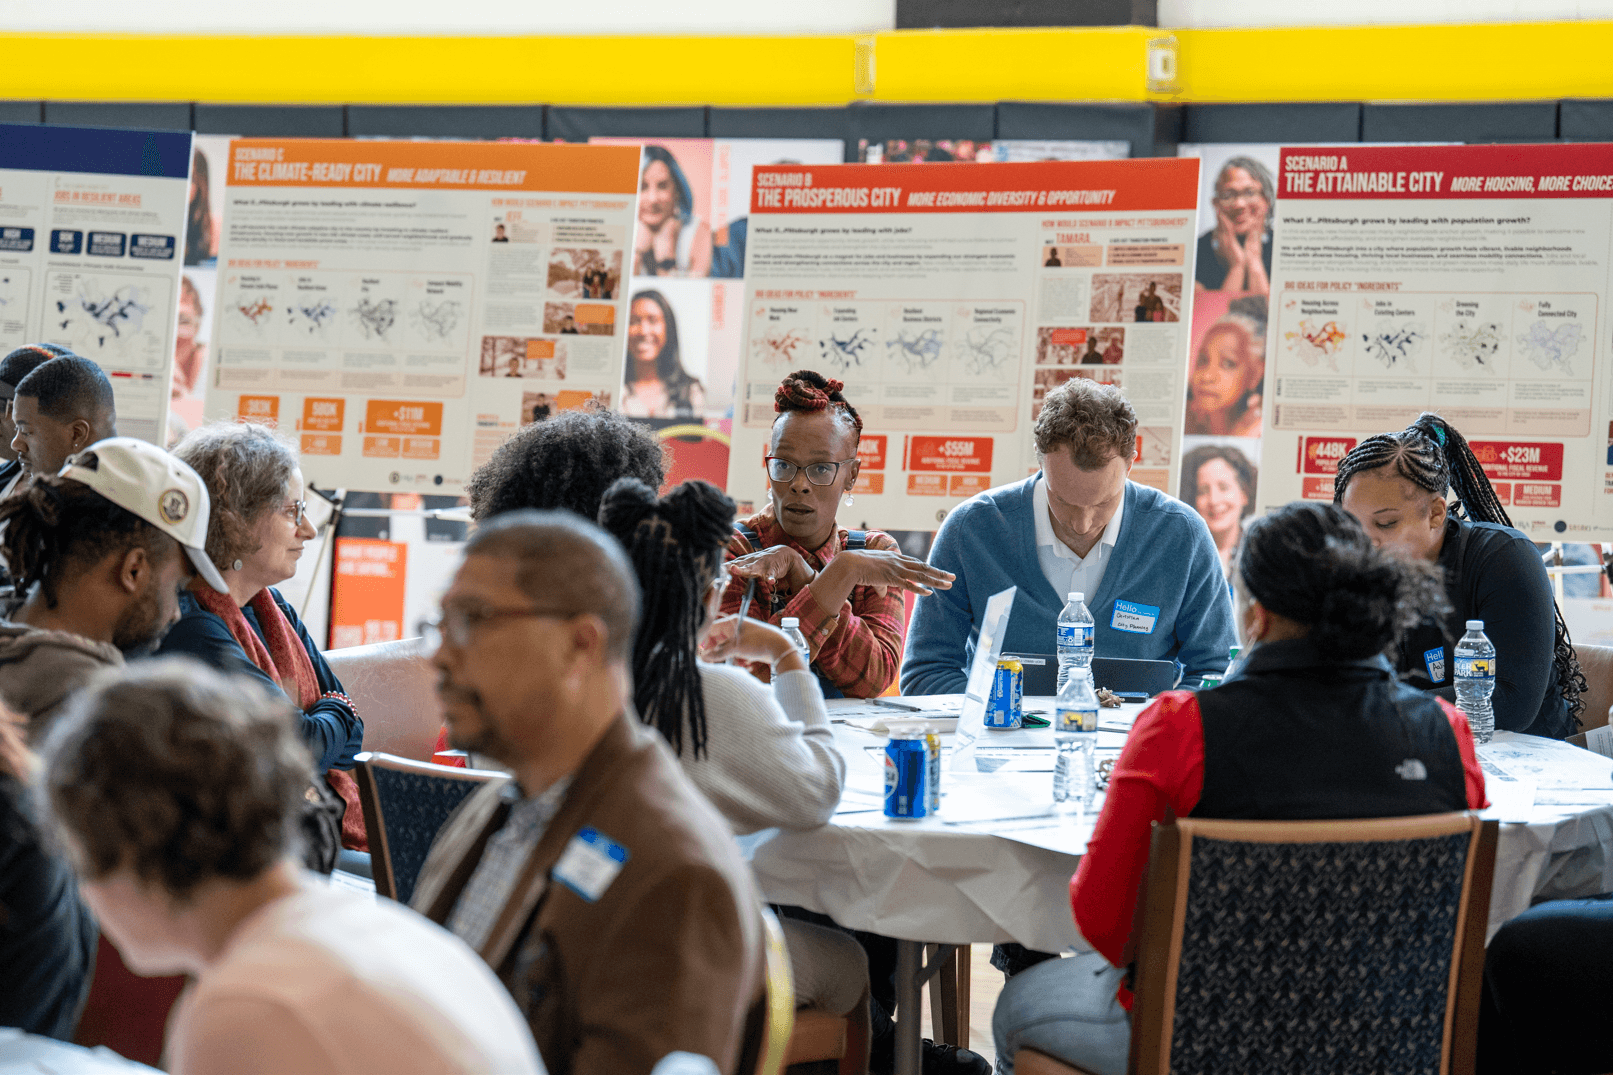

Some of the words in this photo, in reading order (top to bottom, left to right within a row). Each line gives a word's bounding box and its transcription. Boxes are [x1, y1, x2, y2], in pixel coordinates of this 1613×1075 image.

[235, 148, 275, 160] SCENARIO
[1285, 156, 1338, 171] SCENARIO
[1339, 156, 1348, 170] A
[235, 162, 255, 180] THE
[258, 163, 352, 182] CLIMATE-READY
[354, 164, 382, 182] CITY
[386, 168, 415, 182] MORE
[415, 168, 468, 184] ADAPTABLE
[477, 170, 527, 184] RESILIENT
[757, 173, 802, 186] SCENARIO
[1285, 172, 1314, 192] THE
[1316, 172, 1406, 192] ATTAINABLE
[1409, 172, 1444, 192] CITY
[1450, 176, 1484, 192] MORE
[1484, 176, 1535, 193] HOUSING,
[1538, 176, 1572, 191] MORE
[1572, 175, 1613, 191] CHOICE
[756, 188, 783, 208] THE
[785, 188, 868, 207] PROSPEROUS
[871, 188, 901, 207] CITY
[907, 192, 934, 206] MORE
[936, 192, 987, 206] ECONOMIC
[987, 191, 1038, 206] DIVERSITY
[1047, 190, 1116, 205] OPPORTUNITY
[1283, 217, 1304, 225] What
[1362, 217, 1385, 225] grows
[1387, 217, 1397, 225] by
[1296, 282, 1315, 290] IDEAS
[1316, 282, 1328, 290] FOR
[1330, 282, 1352, 290] POLICY
[1317, 442, 1347, 458] 448K
[1497, 446, 1541, 463] +$23M
[1426, 650, 1444, 662] Hell
